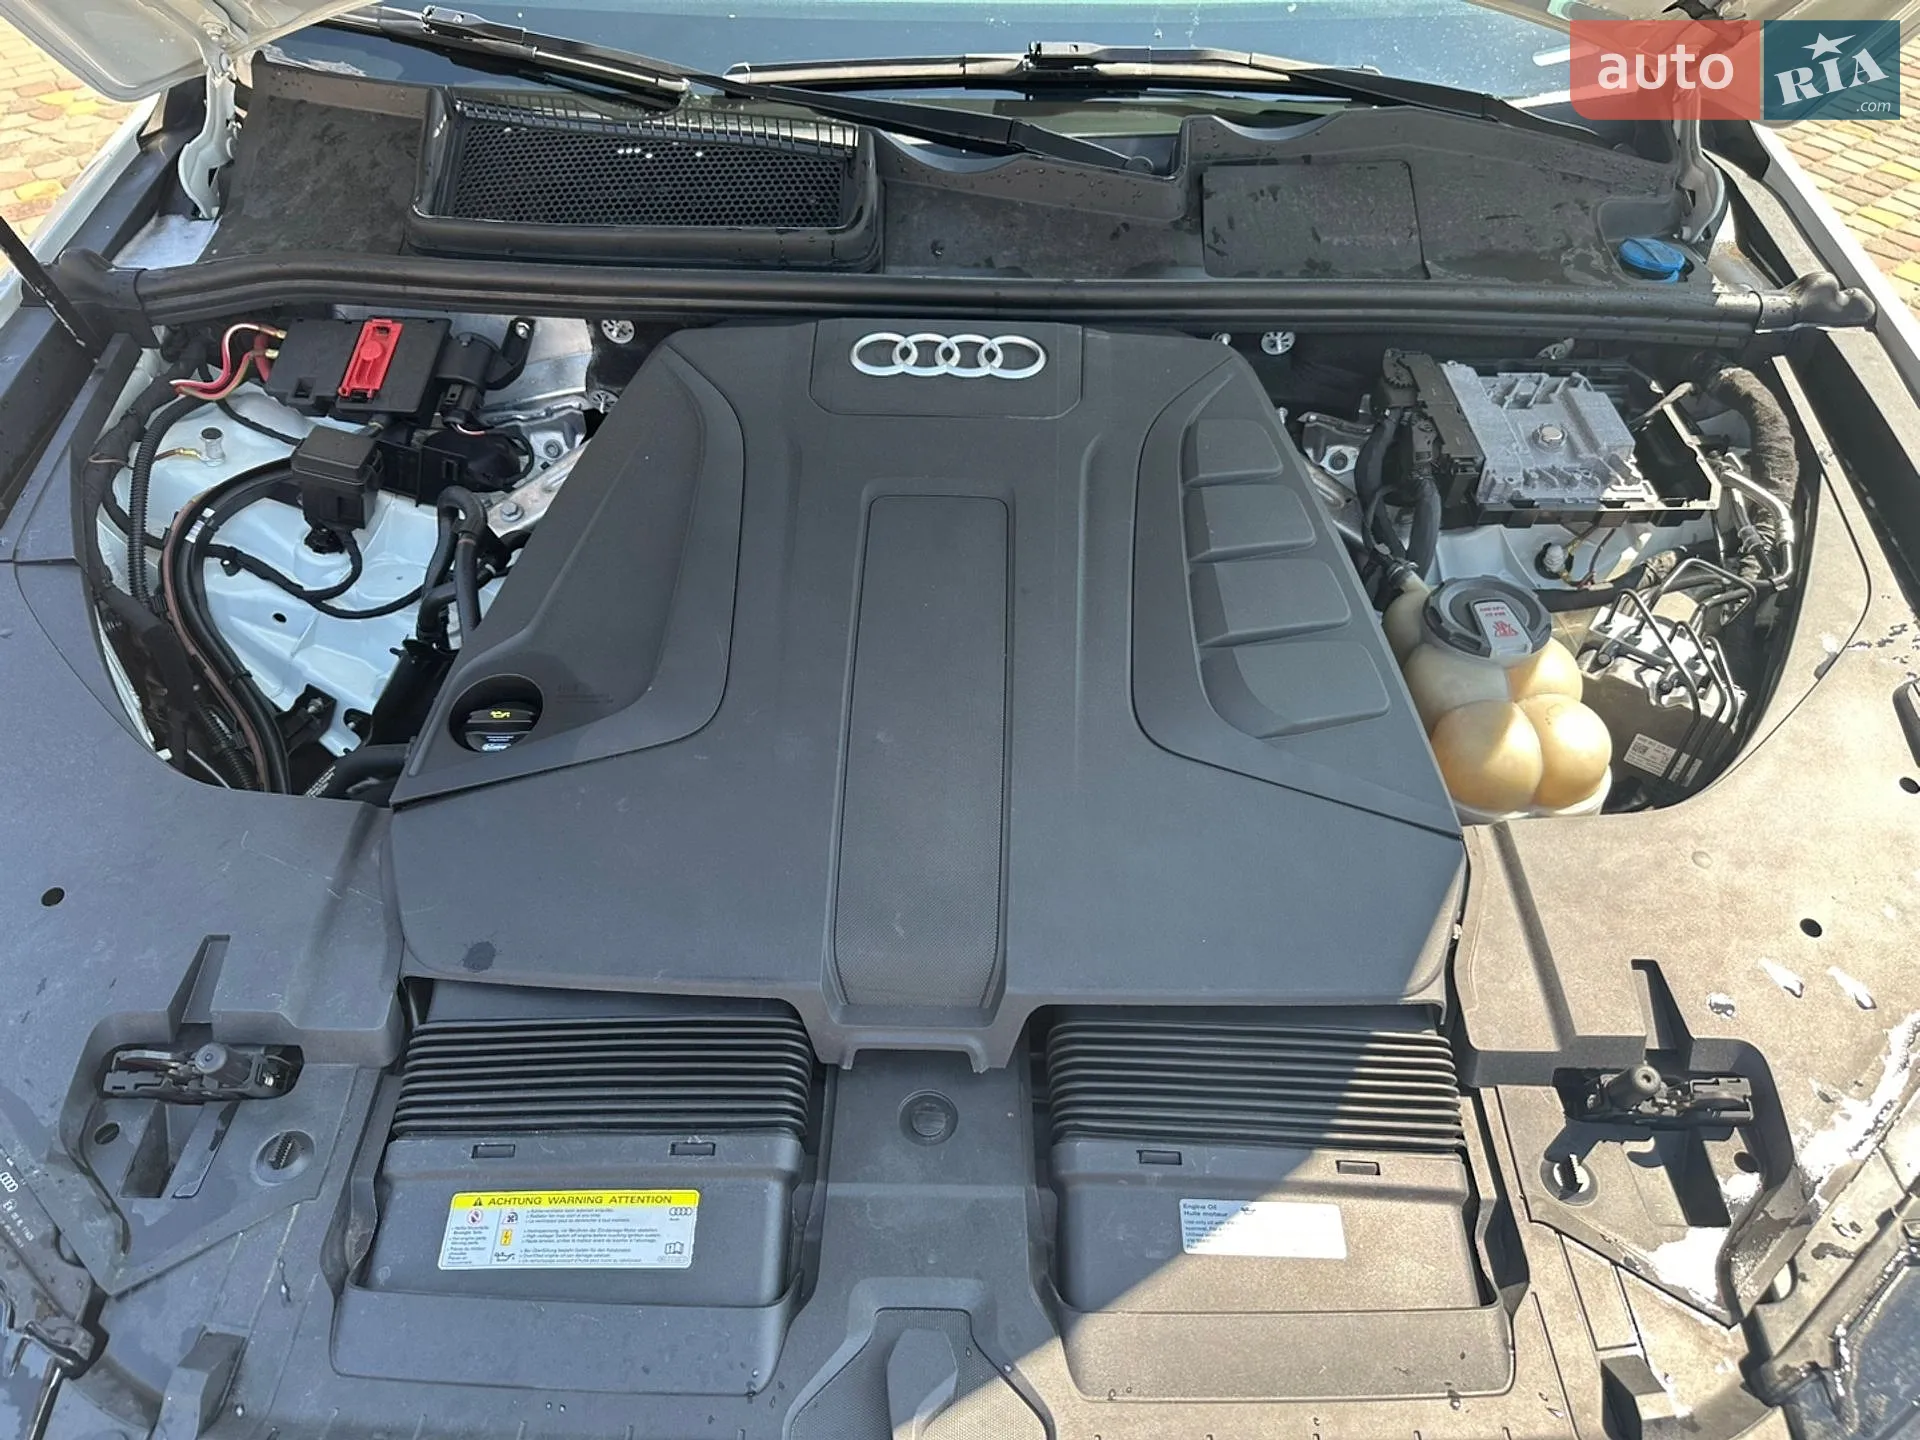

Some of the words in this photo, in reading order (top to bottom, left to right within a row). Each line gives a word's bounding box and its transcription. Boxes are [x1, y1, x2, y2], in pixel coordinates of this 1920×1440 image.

[488, 1197, 542, 1206] ACHTUNG
[548, 1196, 603, 1205] WARNING
[609, 1195, 672, 1204] ATTENTION
